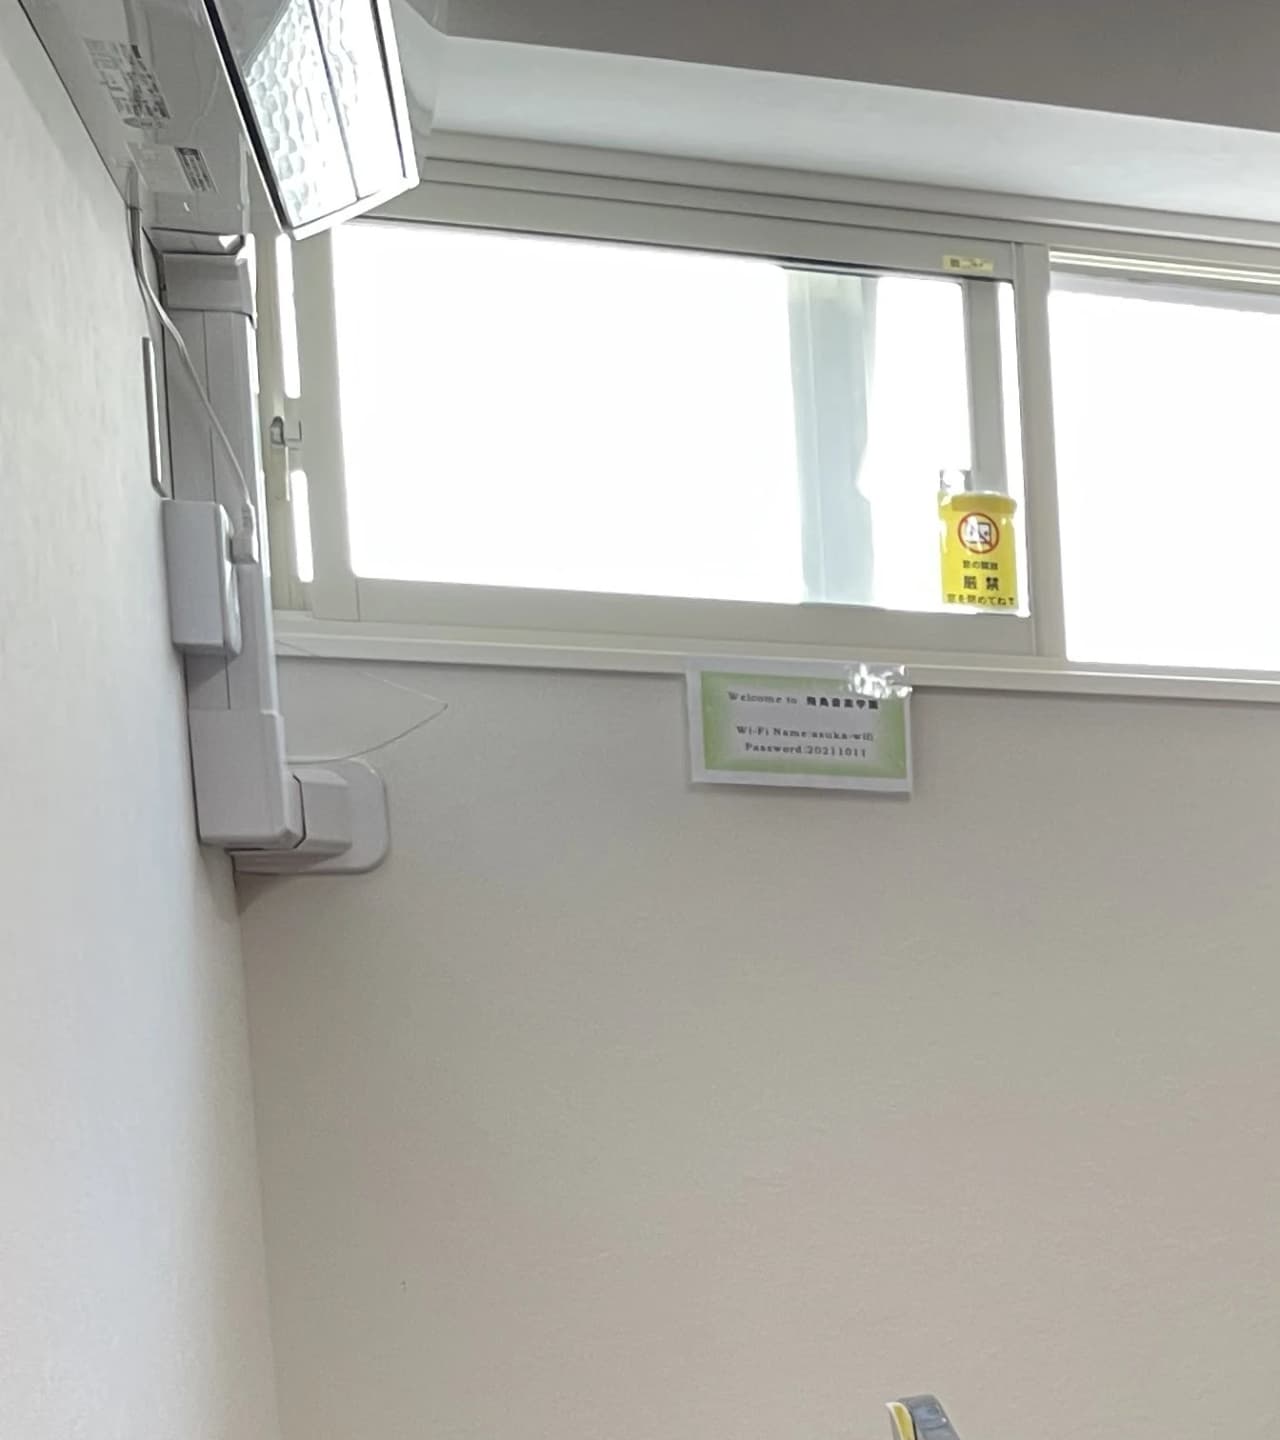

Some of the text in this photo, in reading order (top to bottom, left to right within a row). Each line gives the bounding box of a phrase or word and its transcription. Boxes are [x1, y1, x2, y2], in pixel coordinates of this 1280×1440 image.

[728, 691, 782, 704] Welcome
[787, 696, 798, 705] to
[736, 725, 769, 737] Wi-Fi
